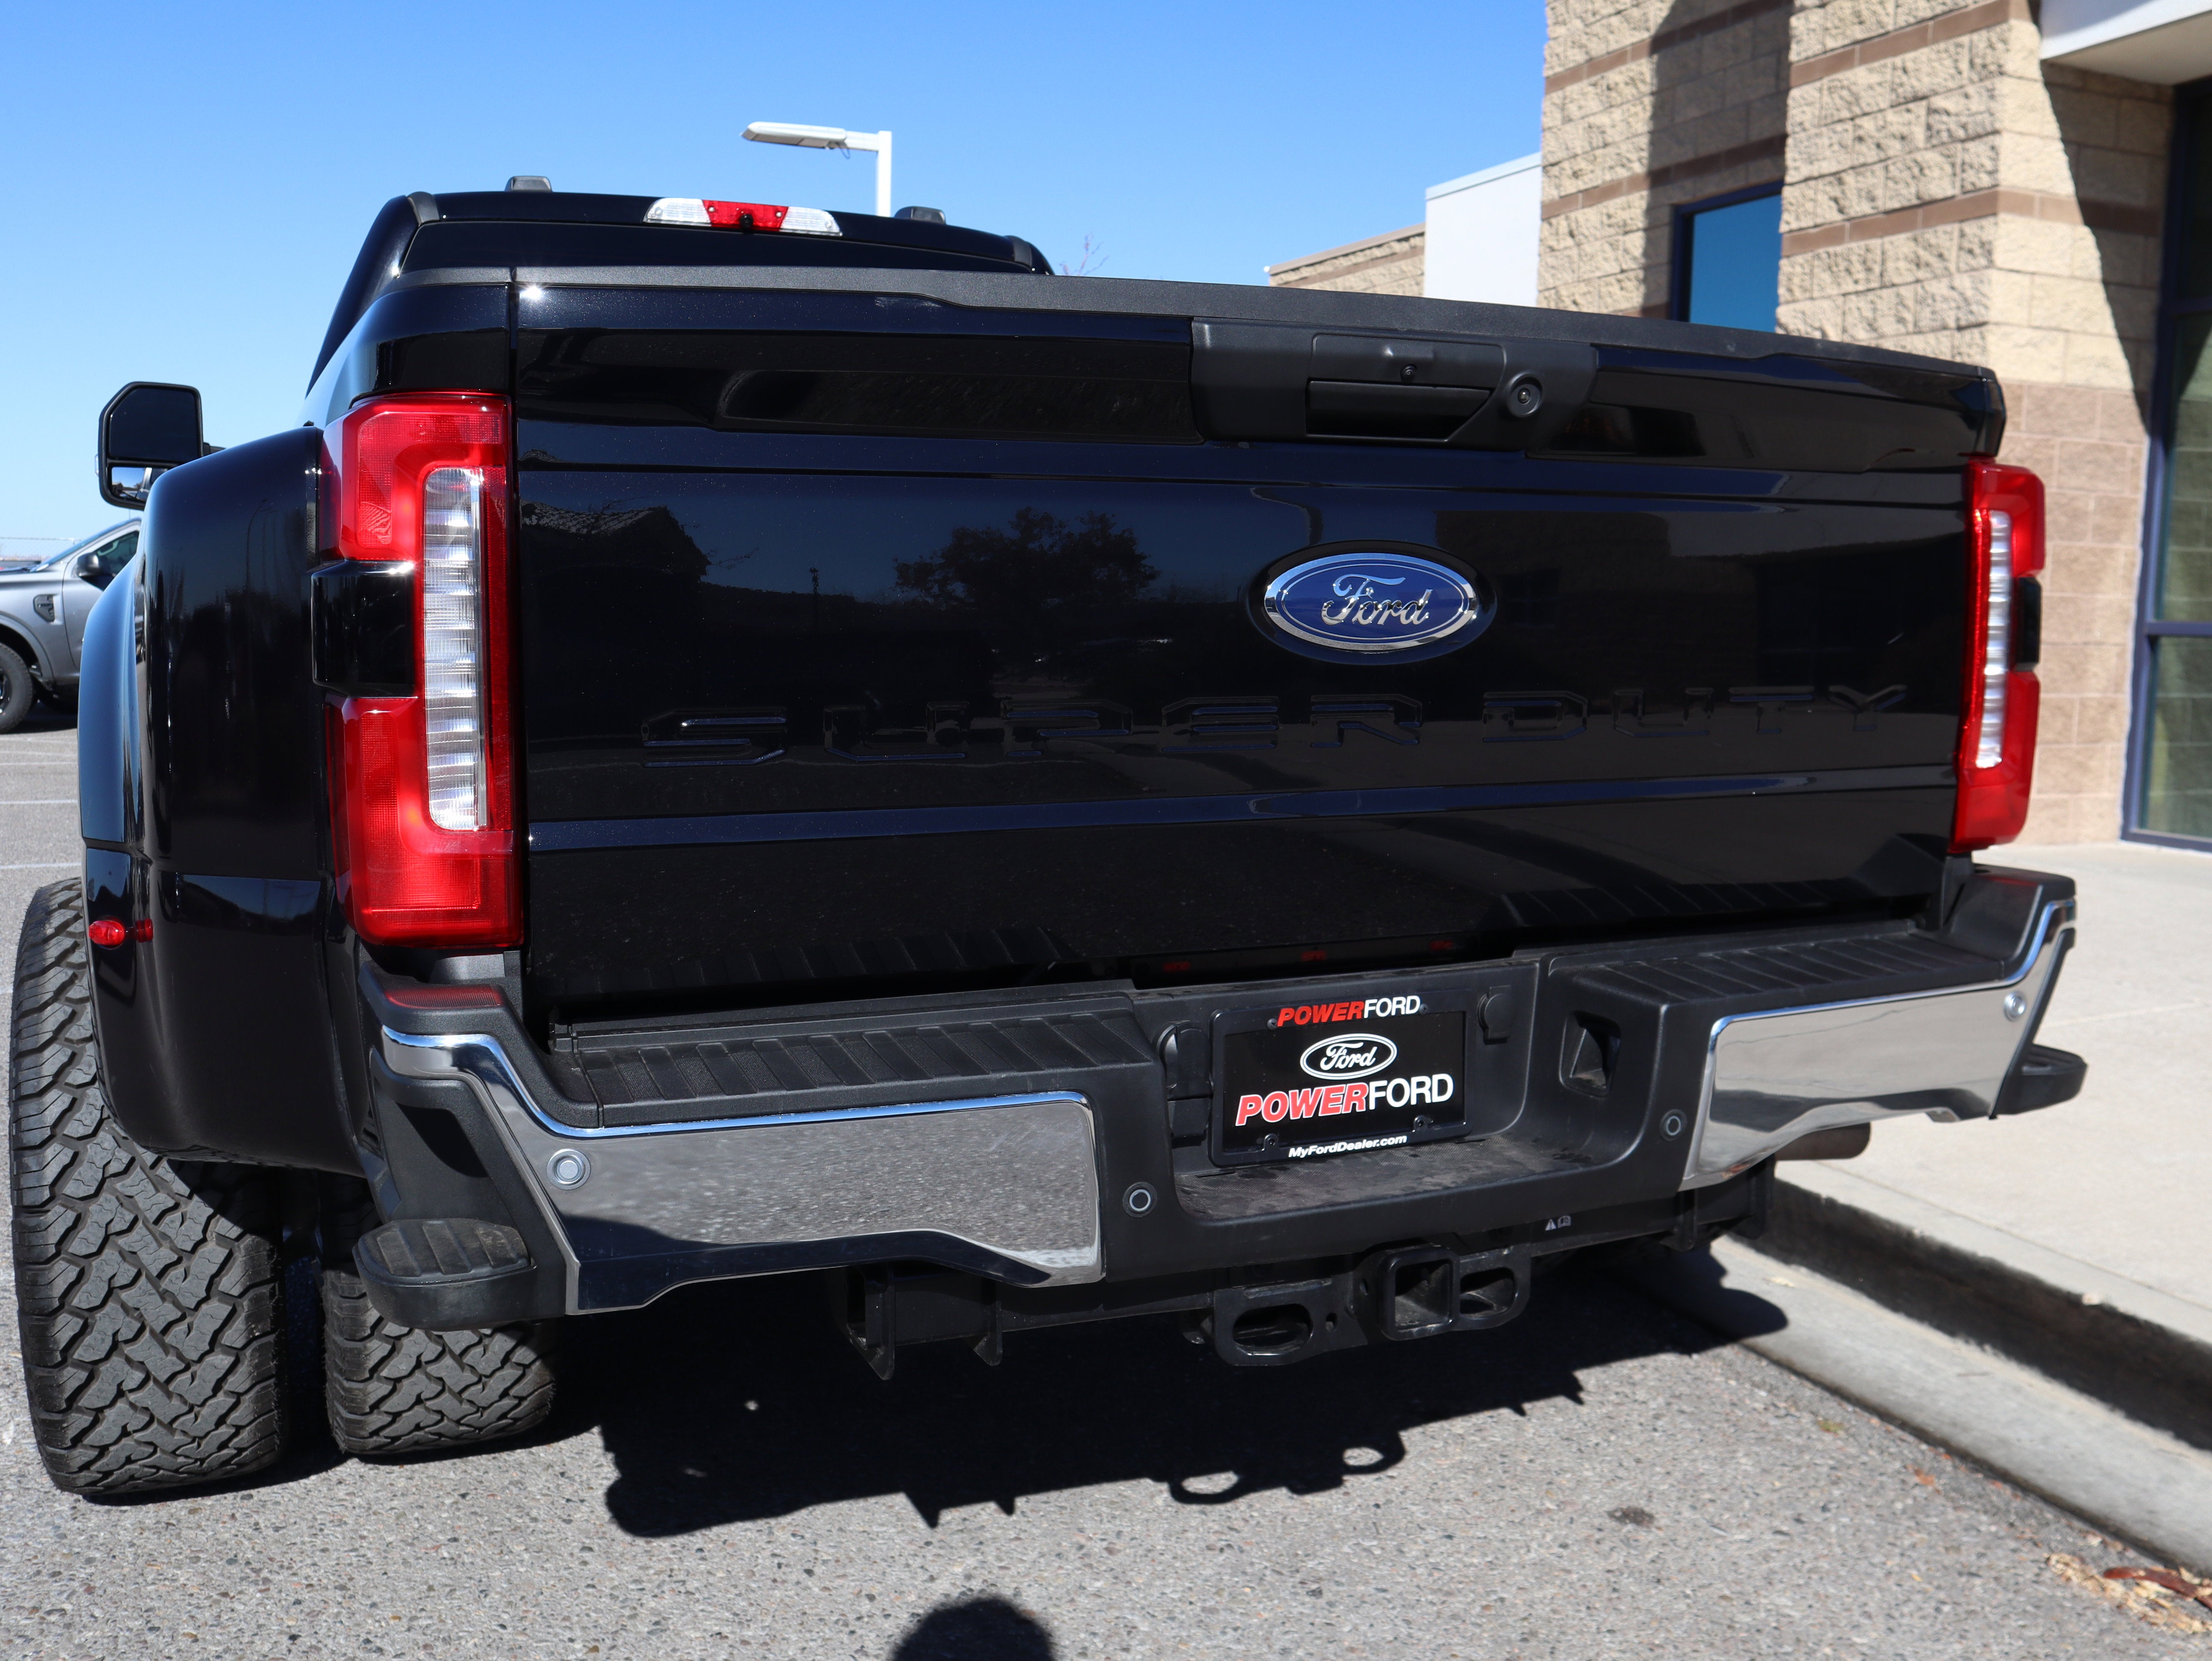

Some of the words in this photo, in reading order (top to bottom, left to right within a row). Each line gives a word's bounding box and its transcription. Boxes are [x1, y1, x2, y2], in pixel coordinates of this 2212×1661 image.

[1321, 573, 1433, 625] Ford
[641, 693, 1423, 768] SUPER
[1481, 684, 1908, 744] DUTY
[1320, 1042, 1378, 1071] Ford
[1288, 1135, 1407, 1158] MyFordDealer.com
